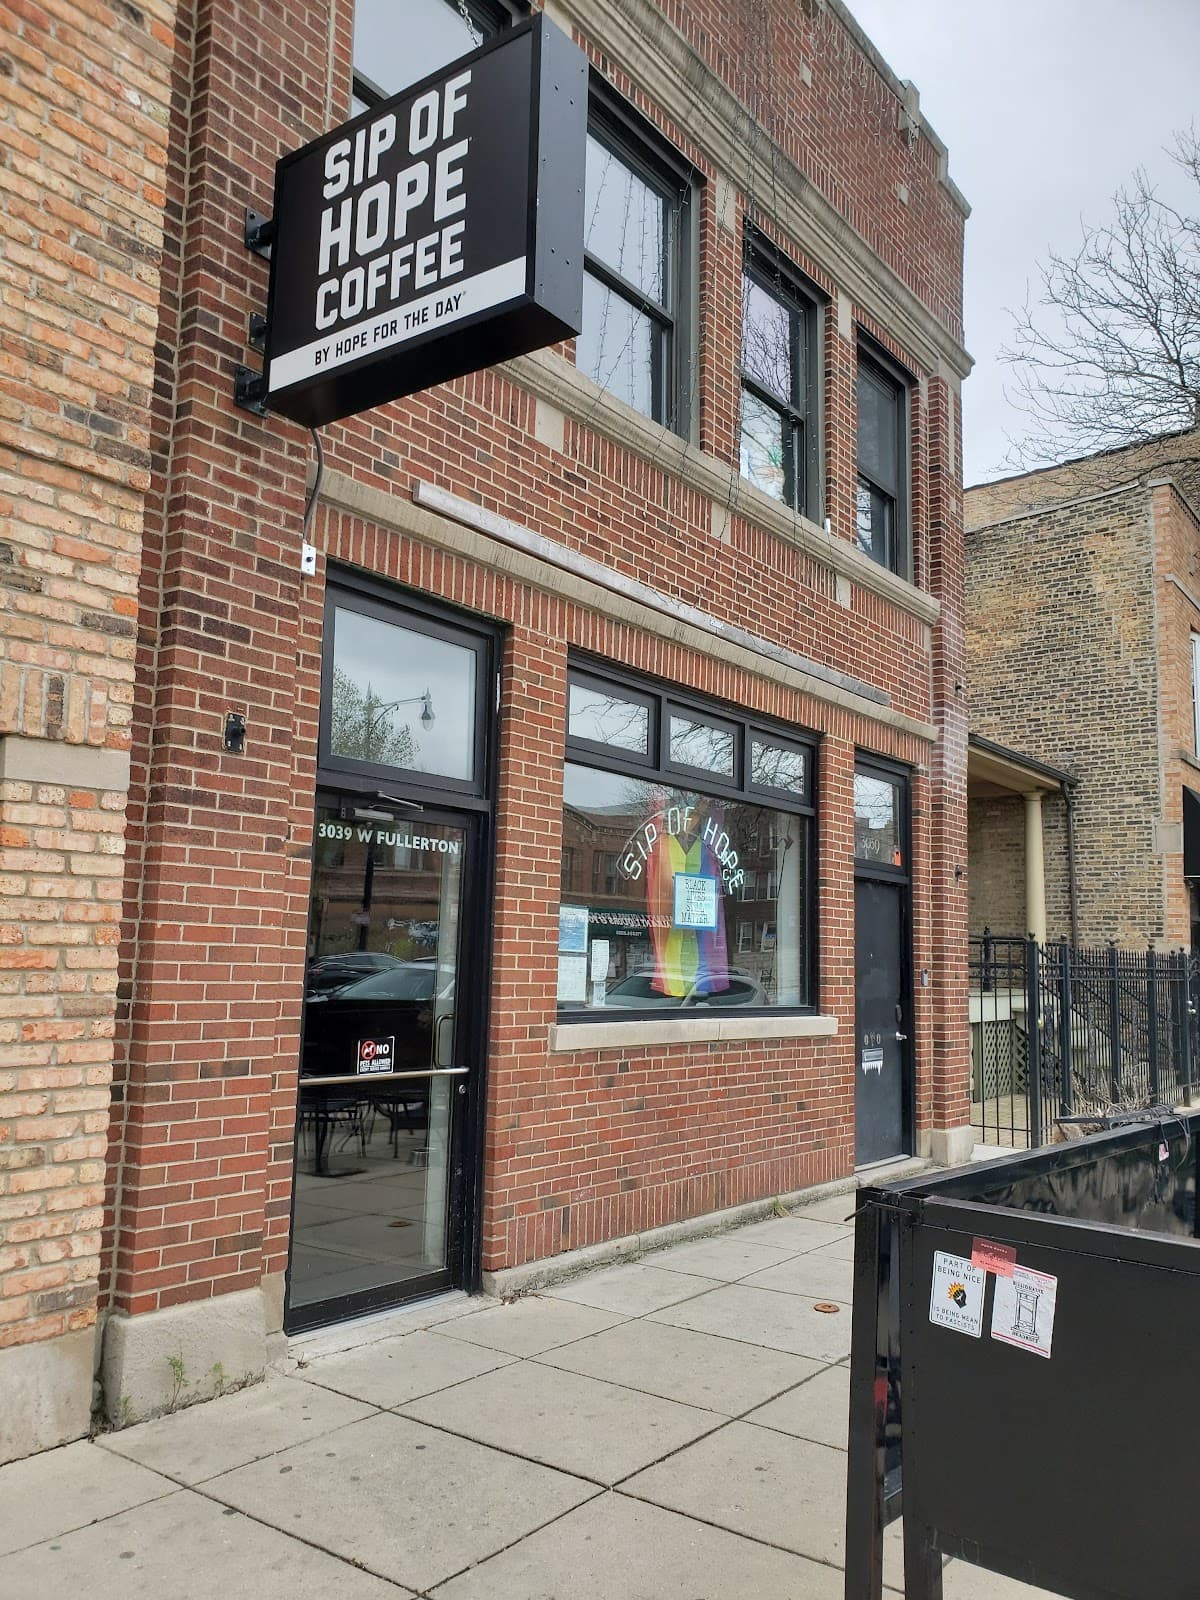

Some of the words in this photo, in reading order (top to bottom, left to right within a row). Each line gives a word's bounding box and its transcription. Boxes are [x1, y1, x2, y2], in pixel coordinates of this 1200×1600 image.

[323, 113, 396, 200] SIP
[408, 69, 472, 156] OF
[318, 138, 469, 275] HOPE
[315, 219, 465, 331] COFFEE
[315, 346, 330, 366] BY
[335, 331, 368, 358] HOPE
[373, 319, 398, 343] FOR
[404, 306, 429, 330] THE
[435, 293, 462, 318] DAY
[318, 822, 353, 840] 3039
[356, 828, 374, 844] W
[376, 831, 460, 855] FULLERTON
[624, 823, 657, 880] SIP
[668, 806, 696, 836] OF
[703, 816, 744, 895] HOPE
[376, 1043, 390, 1055] NO
[937, 1266, 961, 1280] BEING
[963, 1273, 982, 1284] NICE
[943, 1257, 963, 1270] PART
[966, 1263, 977, 1273] OF
[933, 1305, 941, 1313] IS
[941, 1308, 960, 1319] BEING
[961, 1313, 978, 1325] MEAN
[936, 1313, 944, 1322] TO
[945, 1315, 975, 1331] FASCISTS
